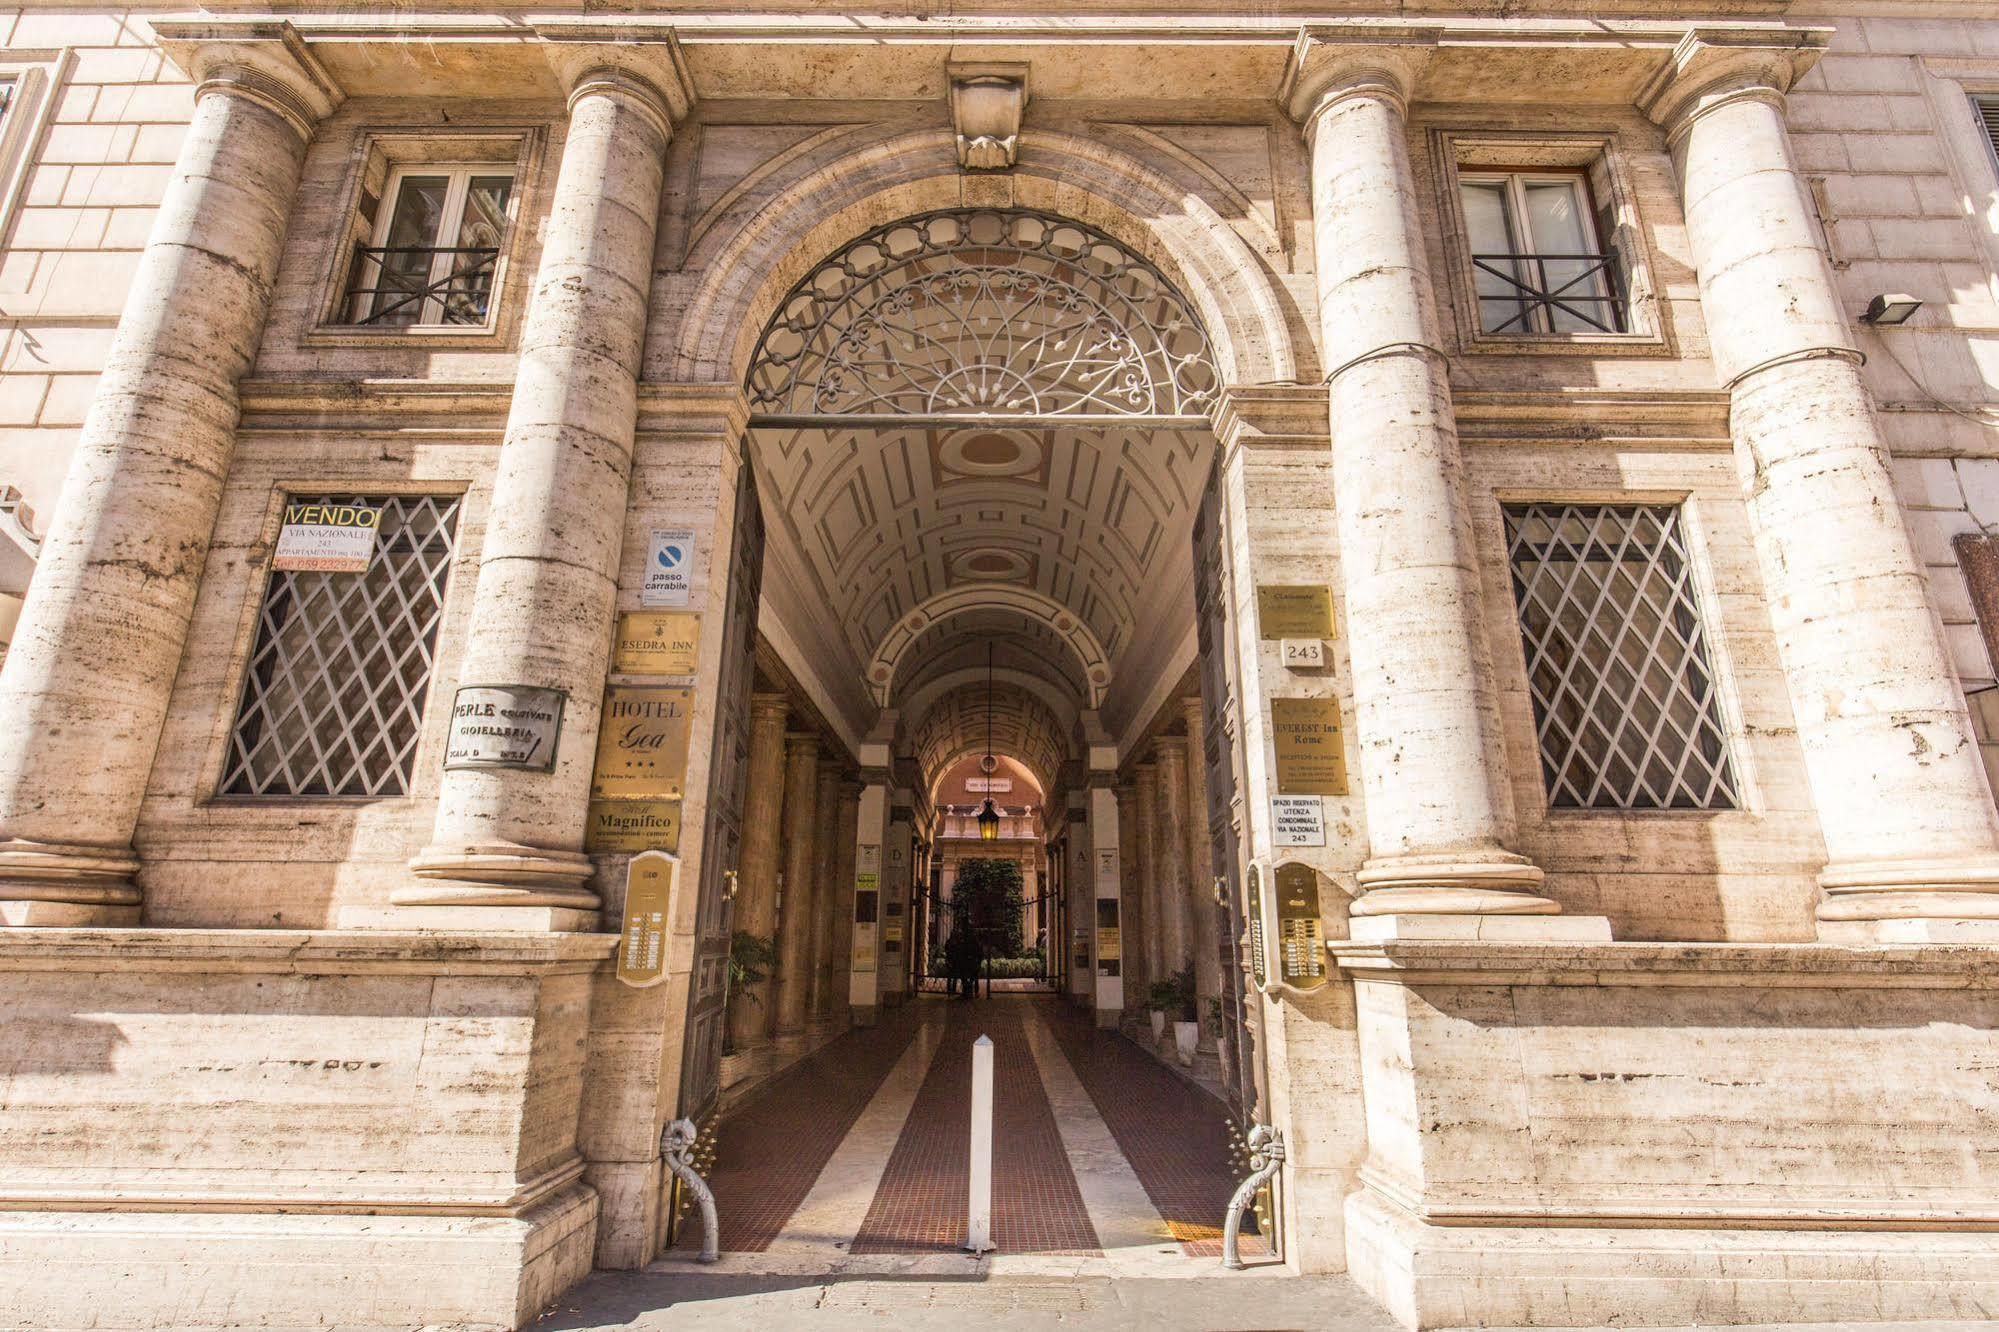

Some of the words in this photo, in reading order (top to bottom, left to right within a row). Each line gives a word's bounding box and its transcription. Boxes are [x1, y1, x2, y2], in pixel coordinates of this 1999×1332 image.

[289, 505, 377, 528] VENDO
[289, 529, 306, 537] VIA
[309, 529, 367, 539] NAZIONALE
[278, 549, 337, 557] APPARTAMENTO
[652, 573, 682, 582] passo
[645, 582, 688, 591] carrabile
[622, 640, 667, 650] ESEDRA
[672, 641, 694, 650] INN
[1287, 646, 1319, 660] 243
[454, 703, 496, 719] PERLE
[611, 701, 683, 719] HOTEL
[460, 726, 533, 738] GIOIELLERIA
[1275, 723, 1320, 733] EVEREST
[1323, 724, 1338, 733] Inn
[1295, 735, 1322, 745] Rome
[1292, 799, 1320, 807] RISERVATO
[599, 814, 672, 830] Magnifico
[1277, 816, 1318, 824] CONDOMINIALE
[1292, 834, 1307, 843] 243
